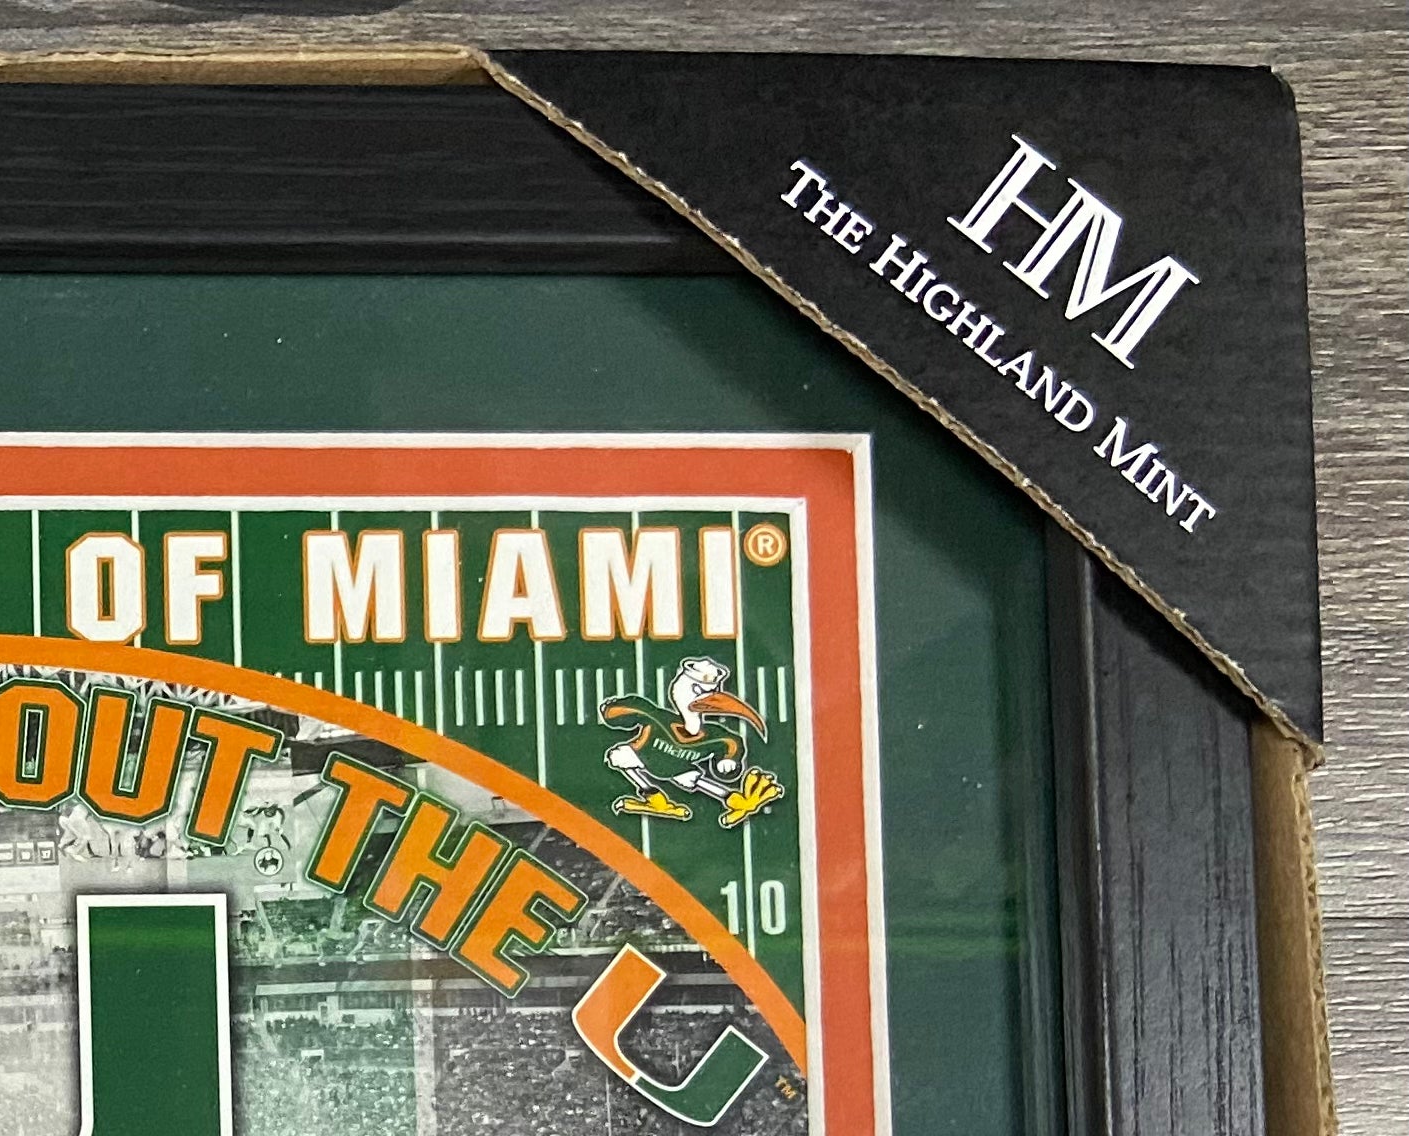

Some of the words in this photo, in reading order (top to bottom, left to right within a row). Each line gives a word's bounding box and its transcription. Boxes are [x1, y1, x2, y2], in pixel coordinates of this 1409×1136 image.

[947, 134, 1200, 369] HM
[65, 530, 229, 646] OF
[301, 525, 741, 644] MIAMI
[305, 750, 590, 1000] THE
[571, 942, 770, 1128] U
[719, 879, 786, 936] 10
